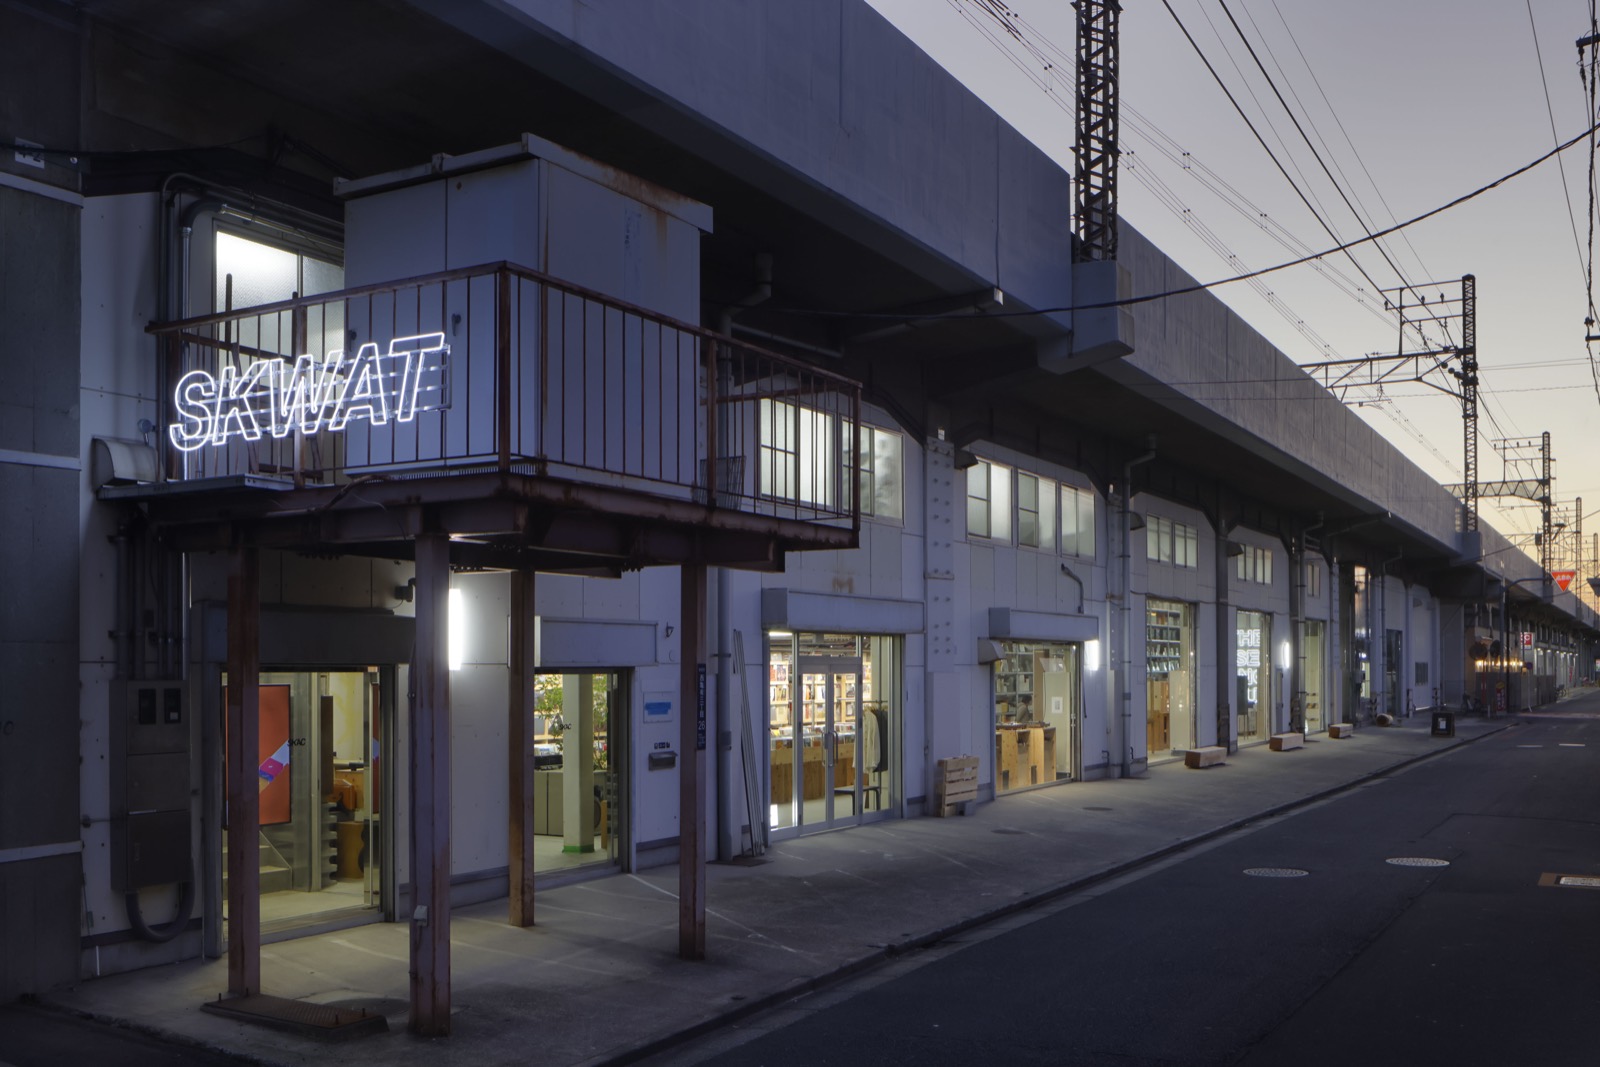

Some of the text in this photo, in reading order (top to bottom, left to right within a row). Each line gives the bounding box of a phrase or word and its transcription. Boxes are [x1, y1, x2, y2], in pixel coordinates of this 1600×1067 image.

[168, 331, 446, 452] SKWAT
[698, 720, 706, 730] 26
[286, 737, 306, 747] SKAC
